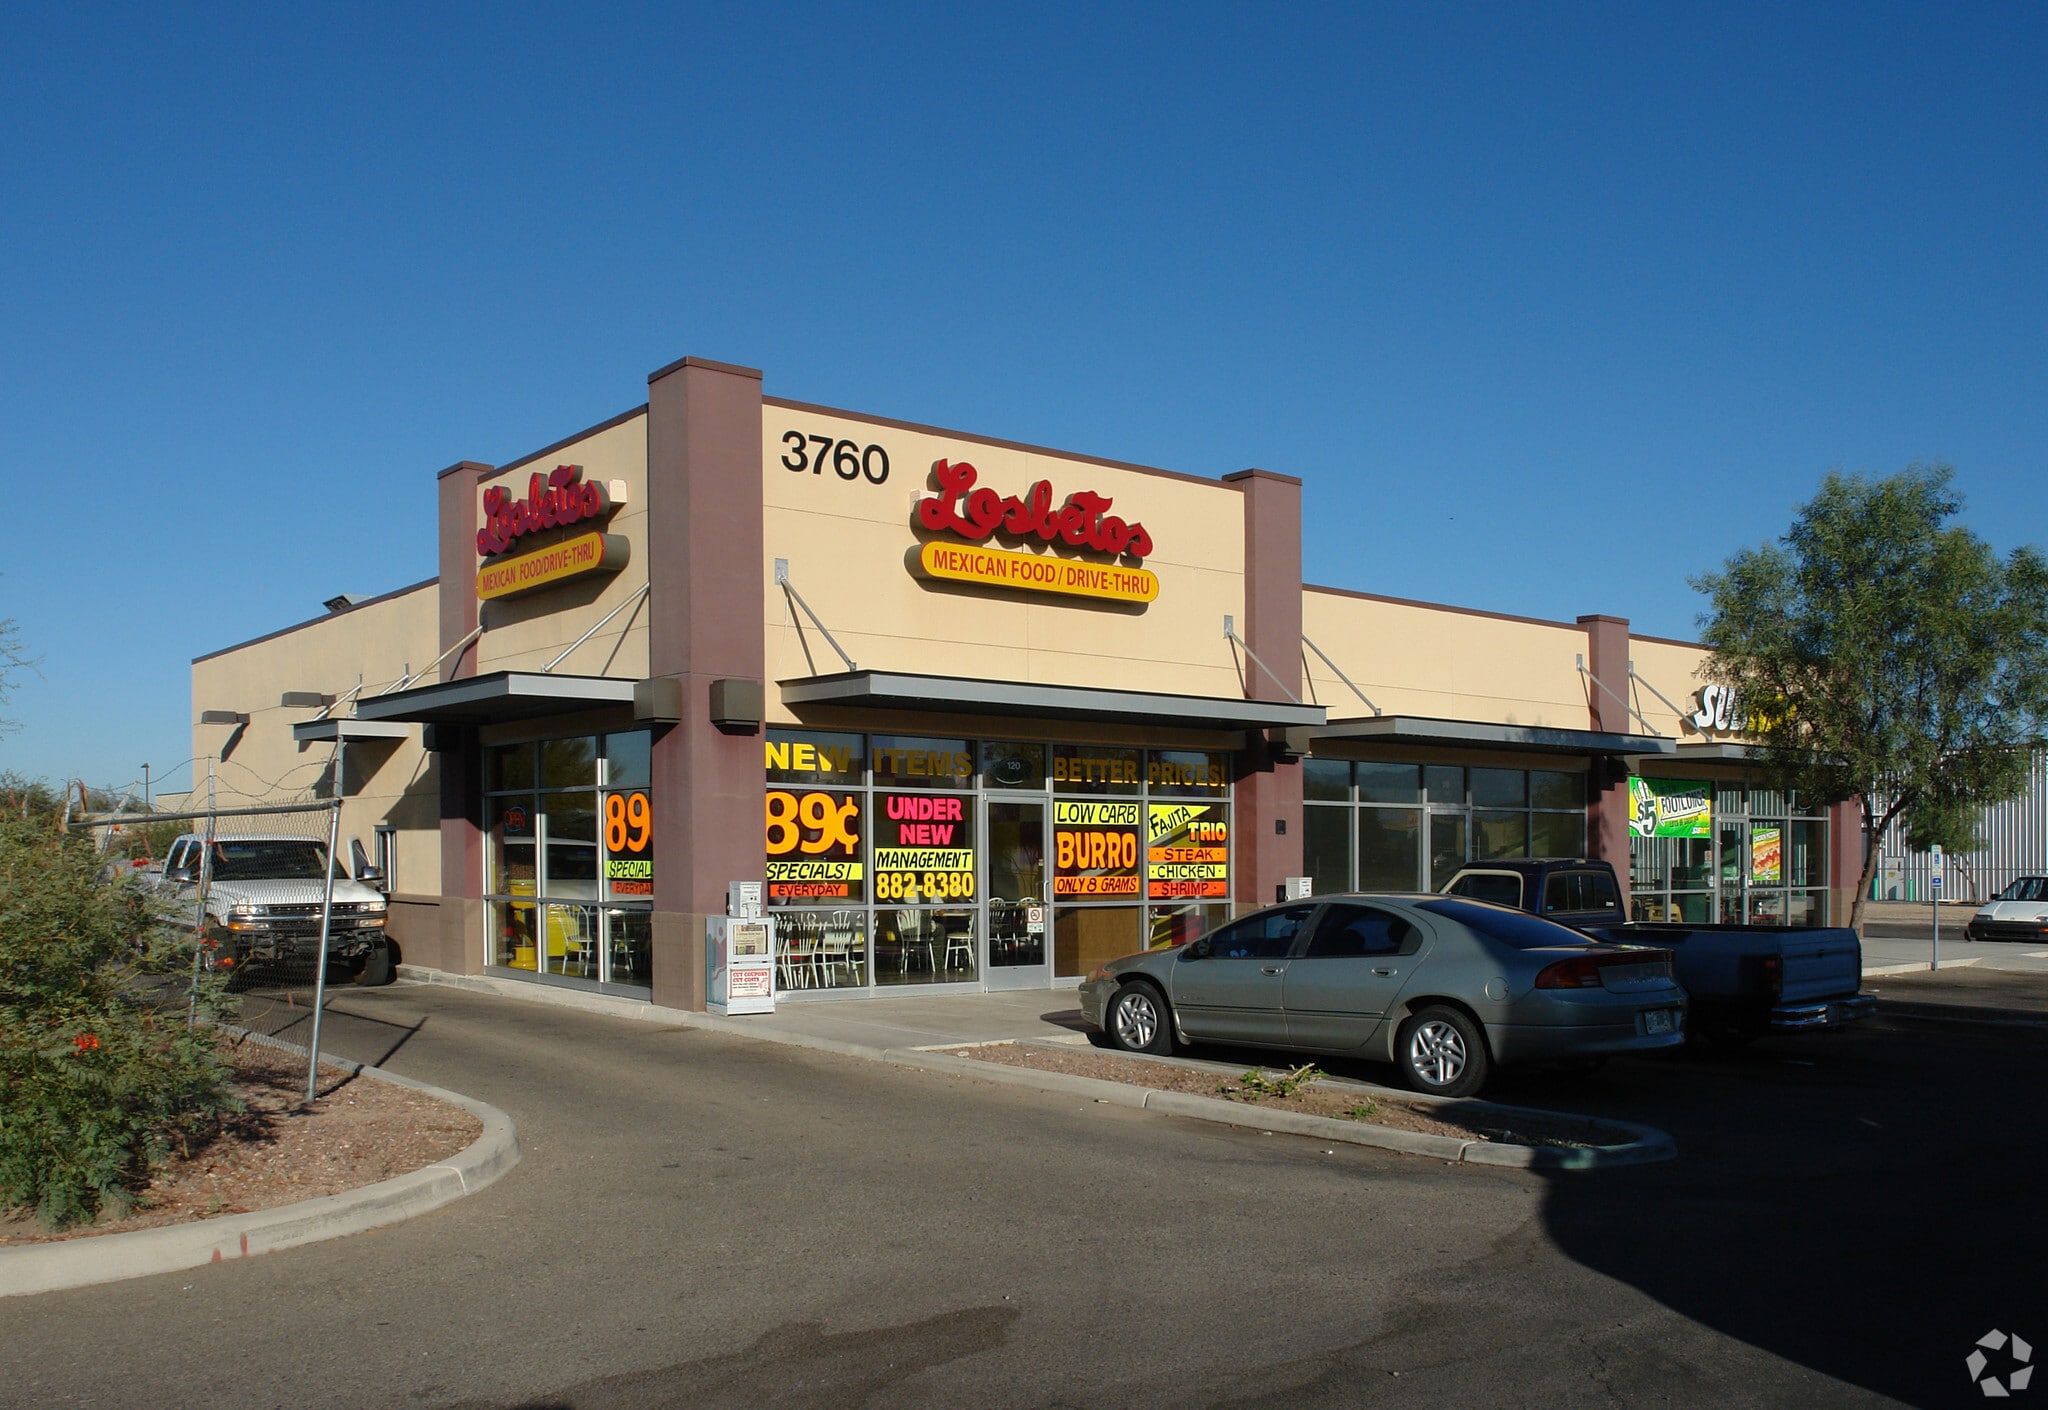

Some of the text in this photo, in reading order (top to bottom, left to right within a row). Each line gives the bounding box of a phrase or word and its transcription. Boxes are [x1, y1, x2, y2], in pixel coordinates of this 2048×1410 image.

[781, 430, 890, 485] 3760
[476, 463, 601, 556] Losbetos
[919, 457, 1154, 557] Losbetos
[933, 549, 1007, 578] MEXICAN
[482, 566, 516, 593] MEXICAN
[766, 742, 973, 778] NEW ITEMS
[1007, 761, 1021, 770] 120
[1053, 757, 1227, 788] BETTER PRICES!
[887, 795, 964, 821] UNDER
[1057, 804, 1137, 824] LOW CARB
[1637, 800, 1657, 835] $5
[766, 791, 860, 855] 89¢
[900, 823, 954, 845] NEW
[1150, 805, 1192, 838] FAJITA
[1186, 820, 1228, 842] TRIO
[876, 851, 971, 869] MANAGEMENT
[1056, 831, 1137, 870] BURRO
[1163, 848, 1214, 861] STEAK
[609, 860, 653, 878] SPECIAL
[1157, 865, 1216, 878] CHICKEN
[777, 884, 842, 897] EVERYDAY
[876, 872, 974, 899] 882-8380
[1056, 877, 1137, 893] ONLY 8 GRAMS
[1161, 883, 1209, 896] SHRIMP
